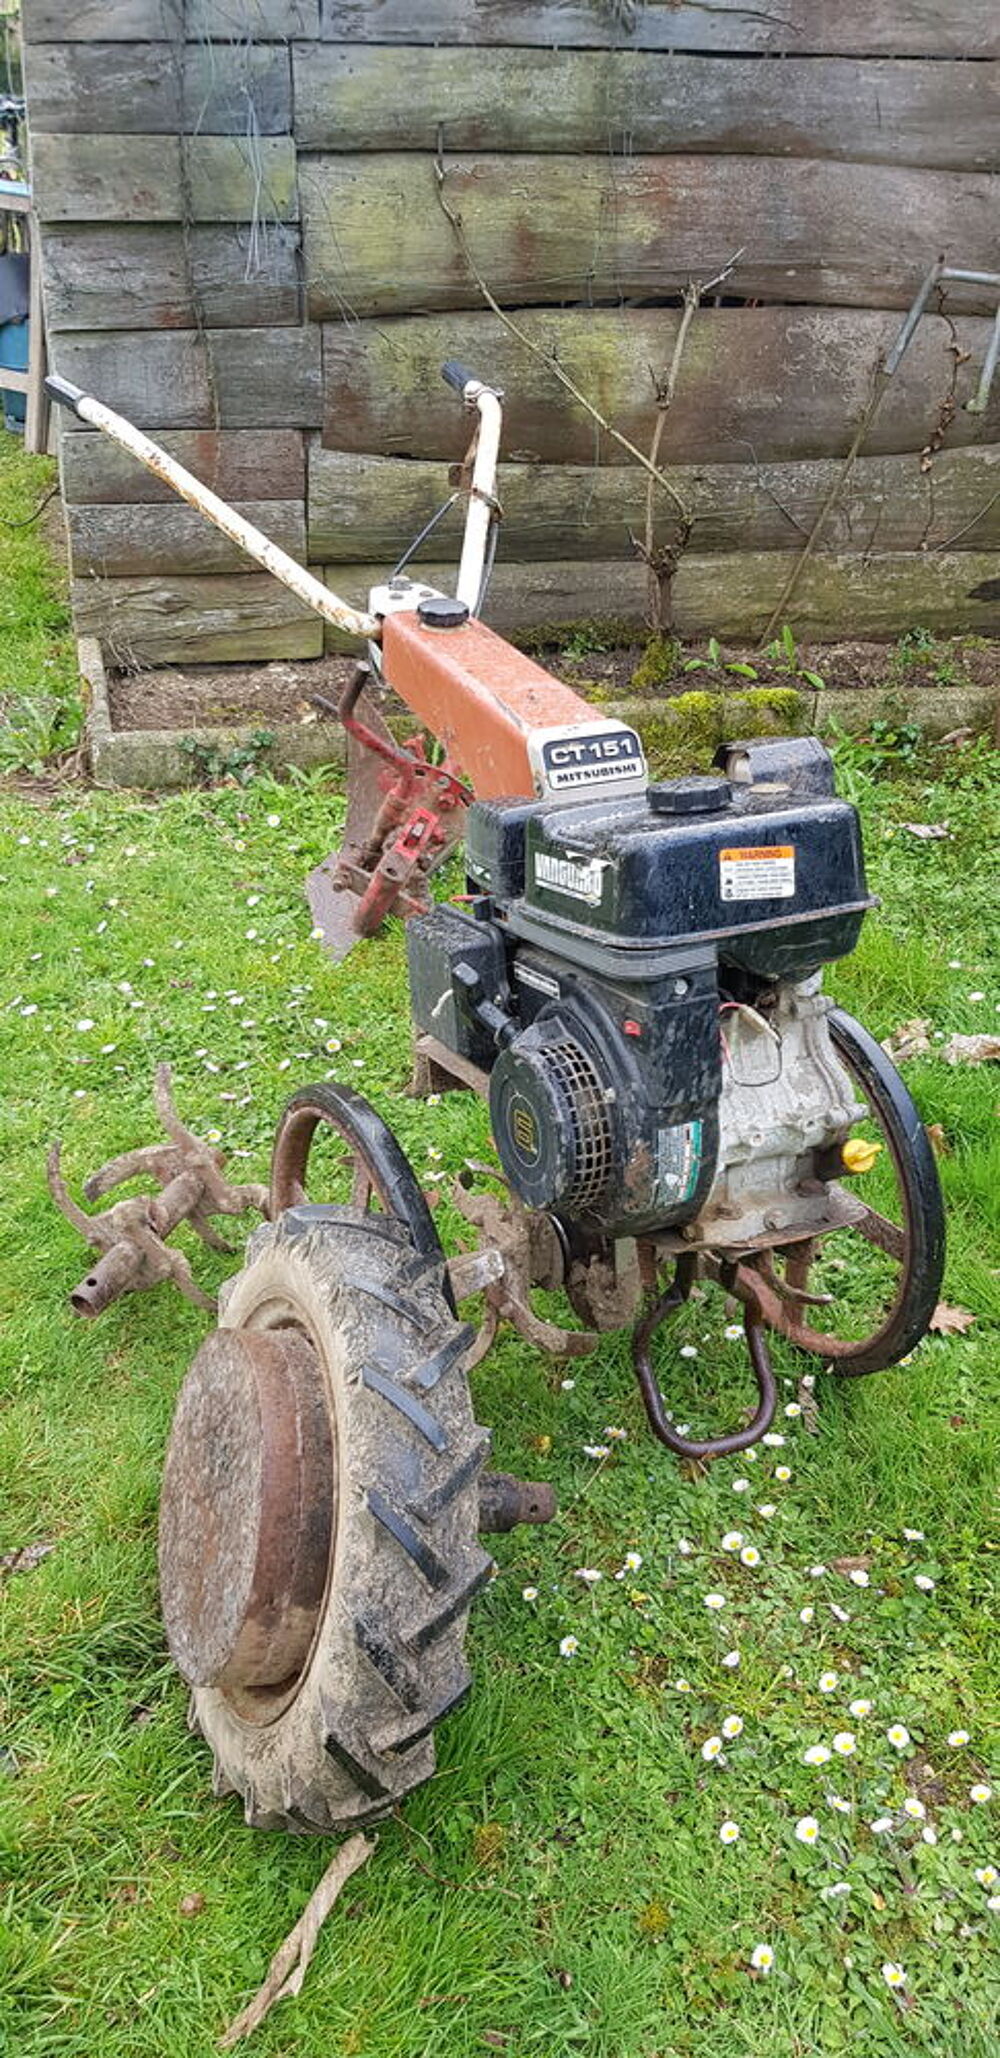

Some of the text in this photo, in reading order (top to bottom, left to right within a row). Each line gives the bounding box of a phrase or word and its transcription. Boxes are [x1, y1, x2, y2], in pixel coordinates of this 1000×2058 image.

[550, 739, 633, 765] CT151
[556, 763, 638, 783] MITSUBISHI
[739, 848, 783, 860] WARNING
